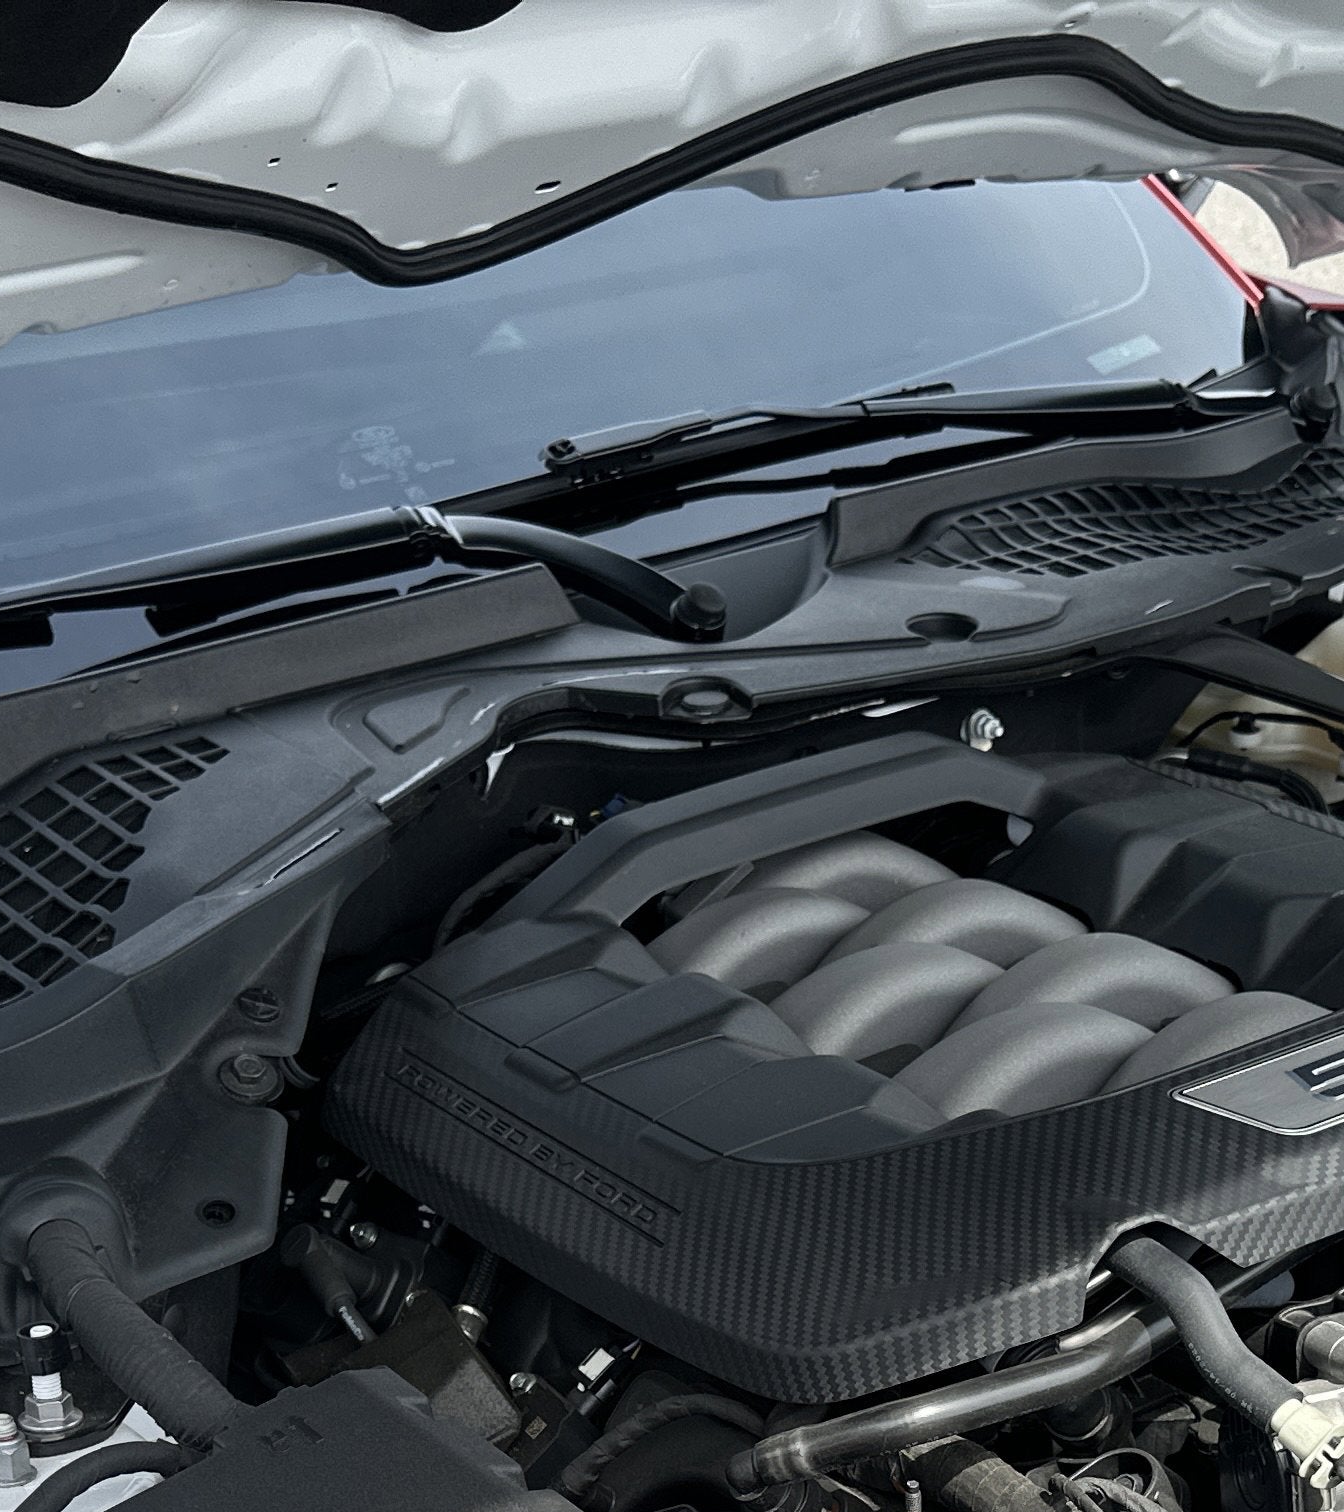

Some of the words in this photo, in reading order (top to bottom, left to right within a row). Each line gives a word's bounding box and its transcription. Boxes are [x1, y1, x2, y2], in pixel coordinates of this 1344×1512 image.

[397, 1063, 529, 1146] POWERED
[529, 1144, 575, 1170] BY
[573, 1169, 657, 1225] FORD
